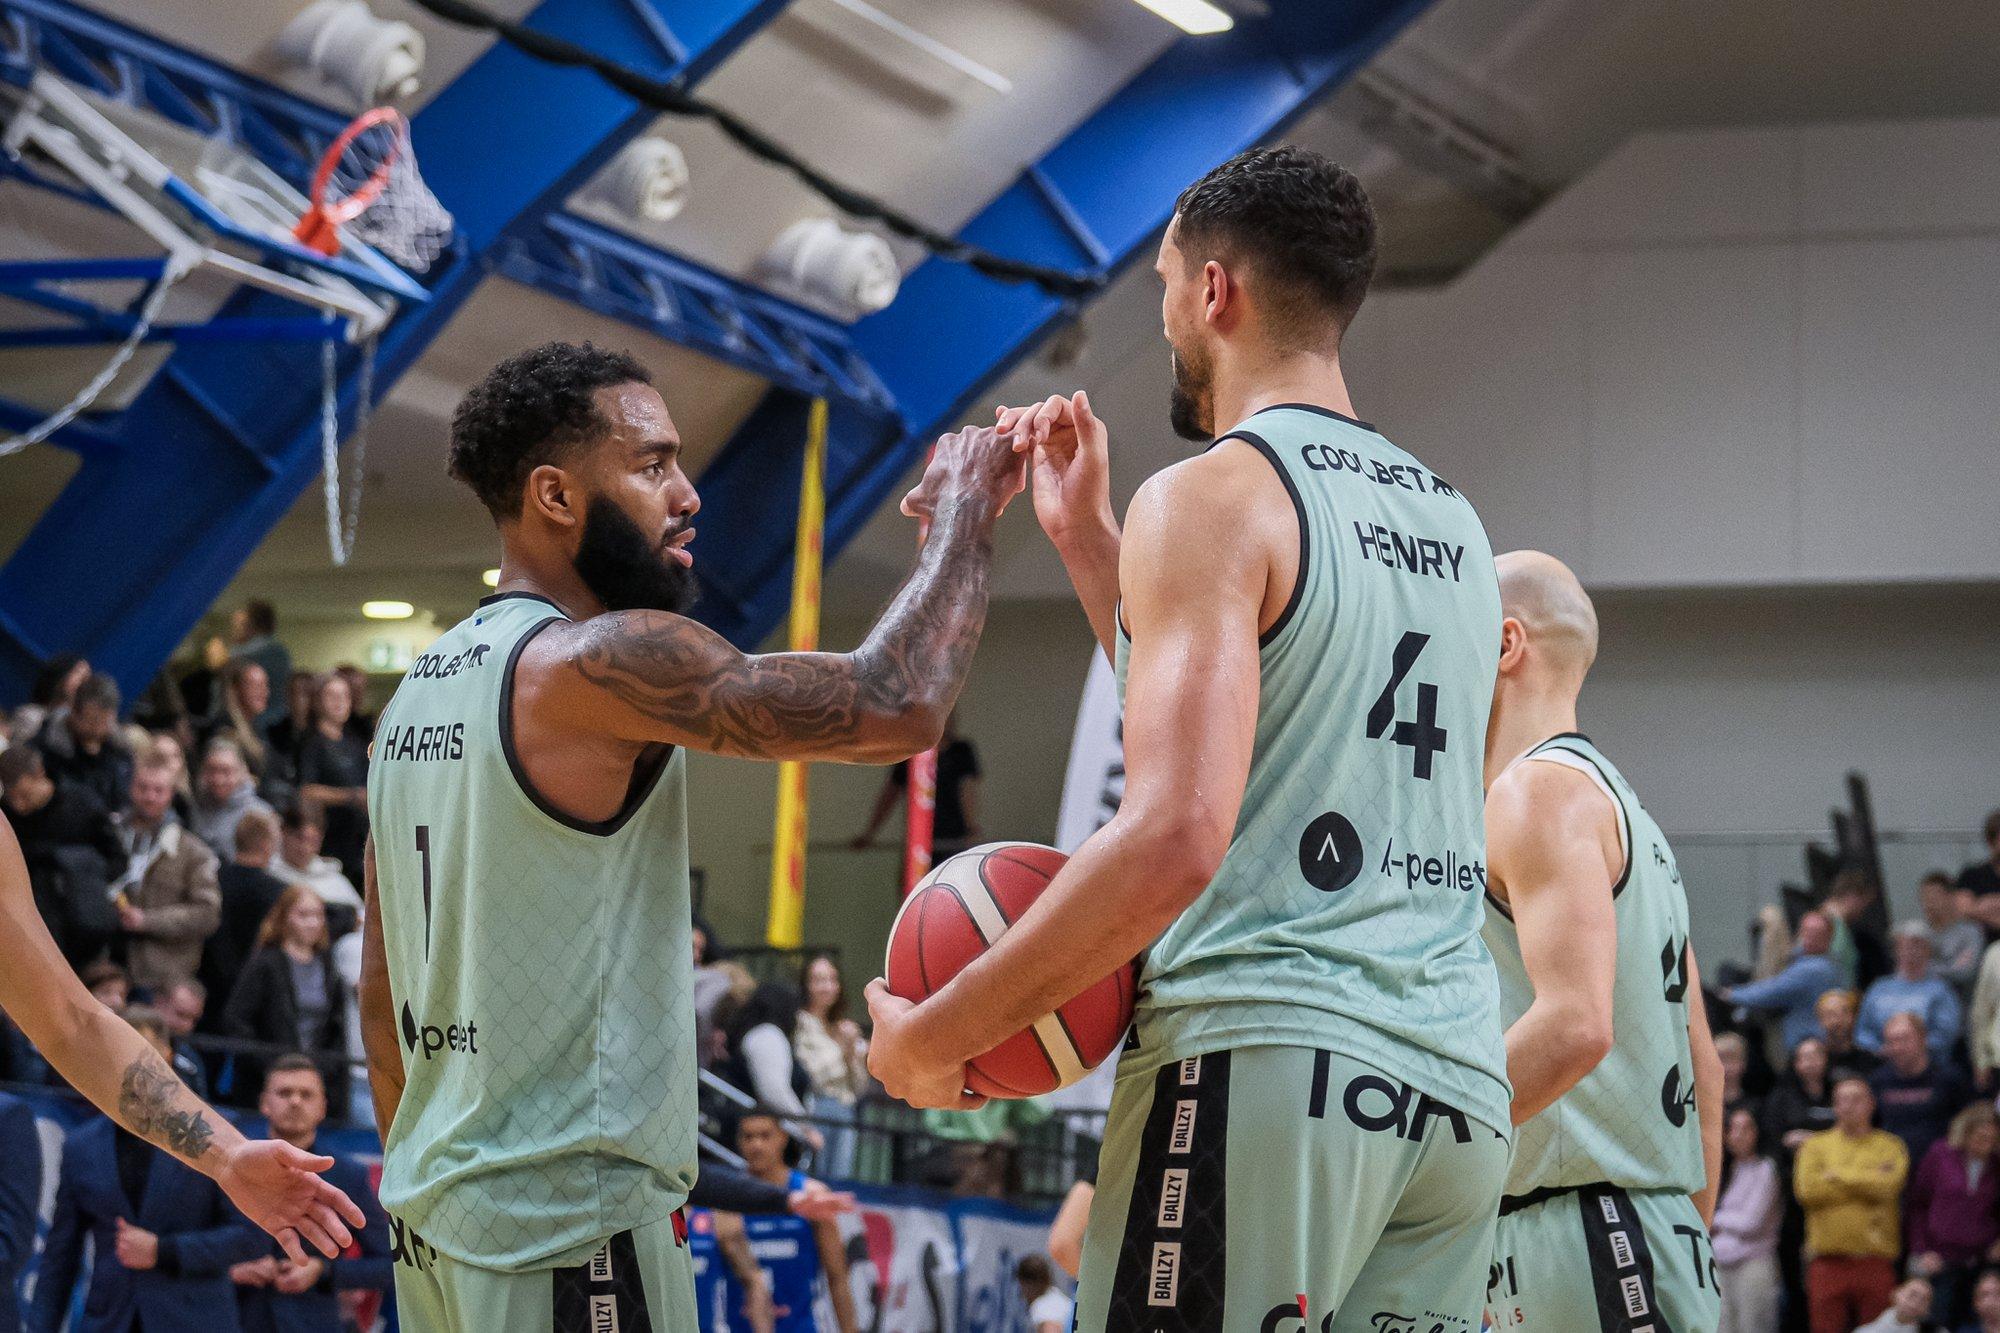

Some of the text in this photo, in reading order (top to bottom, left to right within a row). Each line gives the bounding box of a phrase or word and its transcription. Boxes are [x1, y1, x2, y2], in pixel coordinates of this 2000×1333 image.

[1301, 444, 1426, 493] COOLBET
[1353, 521, 1464, 582] HENRY
[409, 647, 472, 680] OOLBET
[1366, 631, 1447, 780] 4
[384, 723, 464, 761] HARRIS
[416, 826, 431, 964] 1
[1174, 1106, 1192, 1148] BALLZY
[1164, 1175, 1182, 1221] BALLZY
[1614, 1236, 1630, 1263] BALLZY
[1154, 1249, 1174, 1299] BALLZY
[1626, 1282, 1643, 1312] BALLZY
